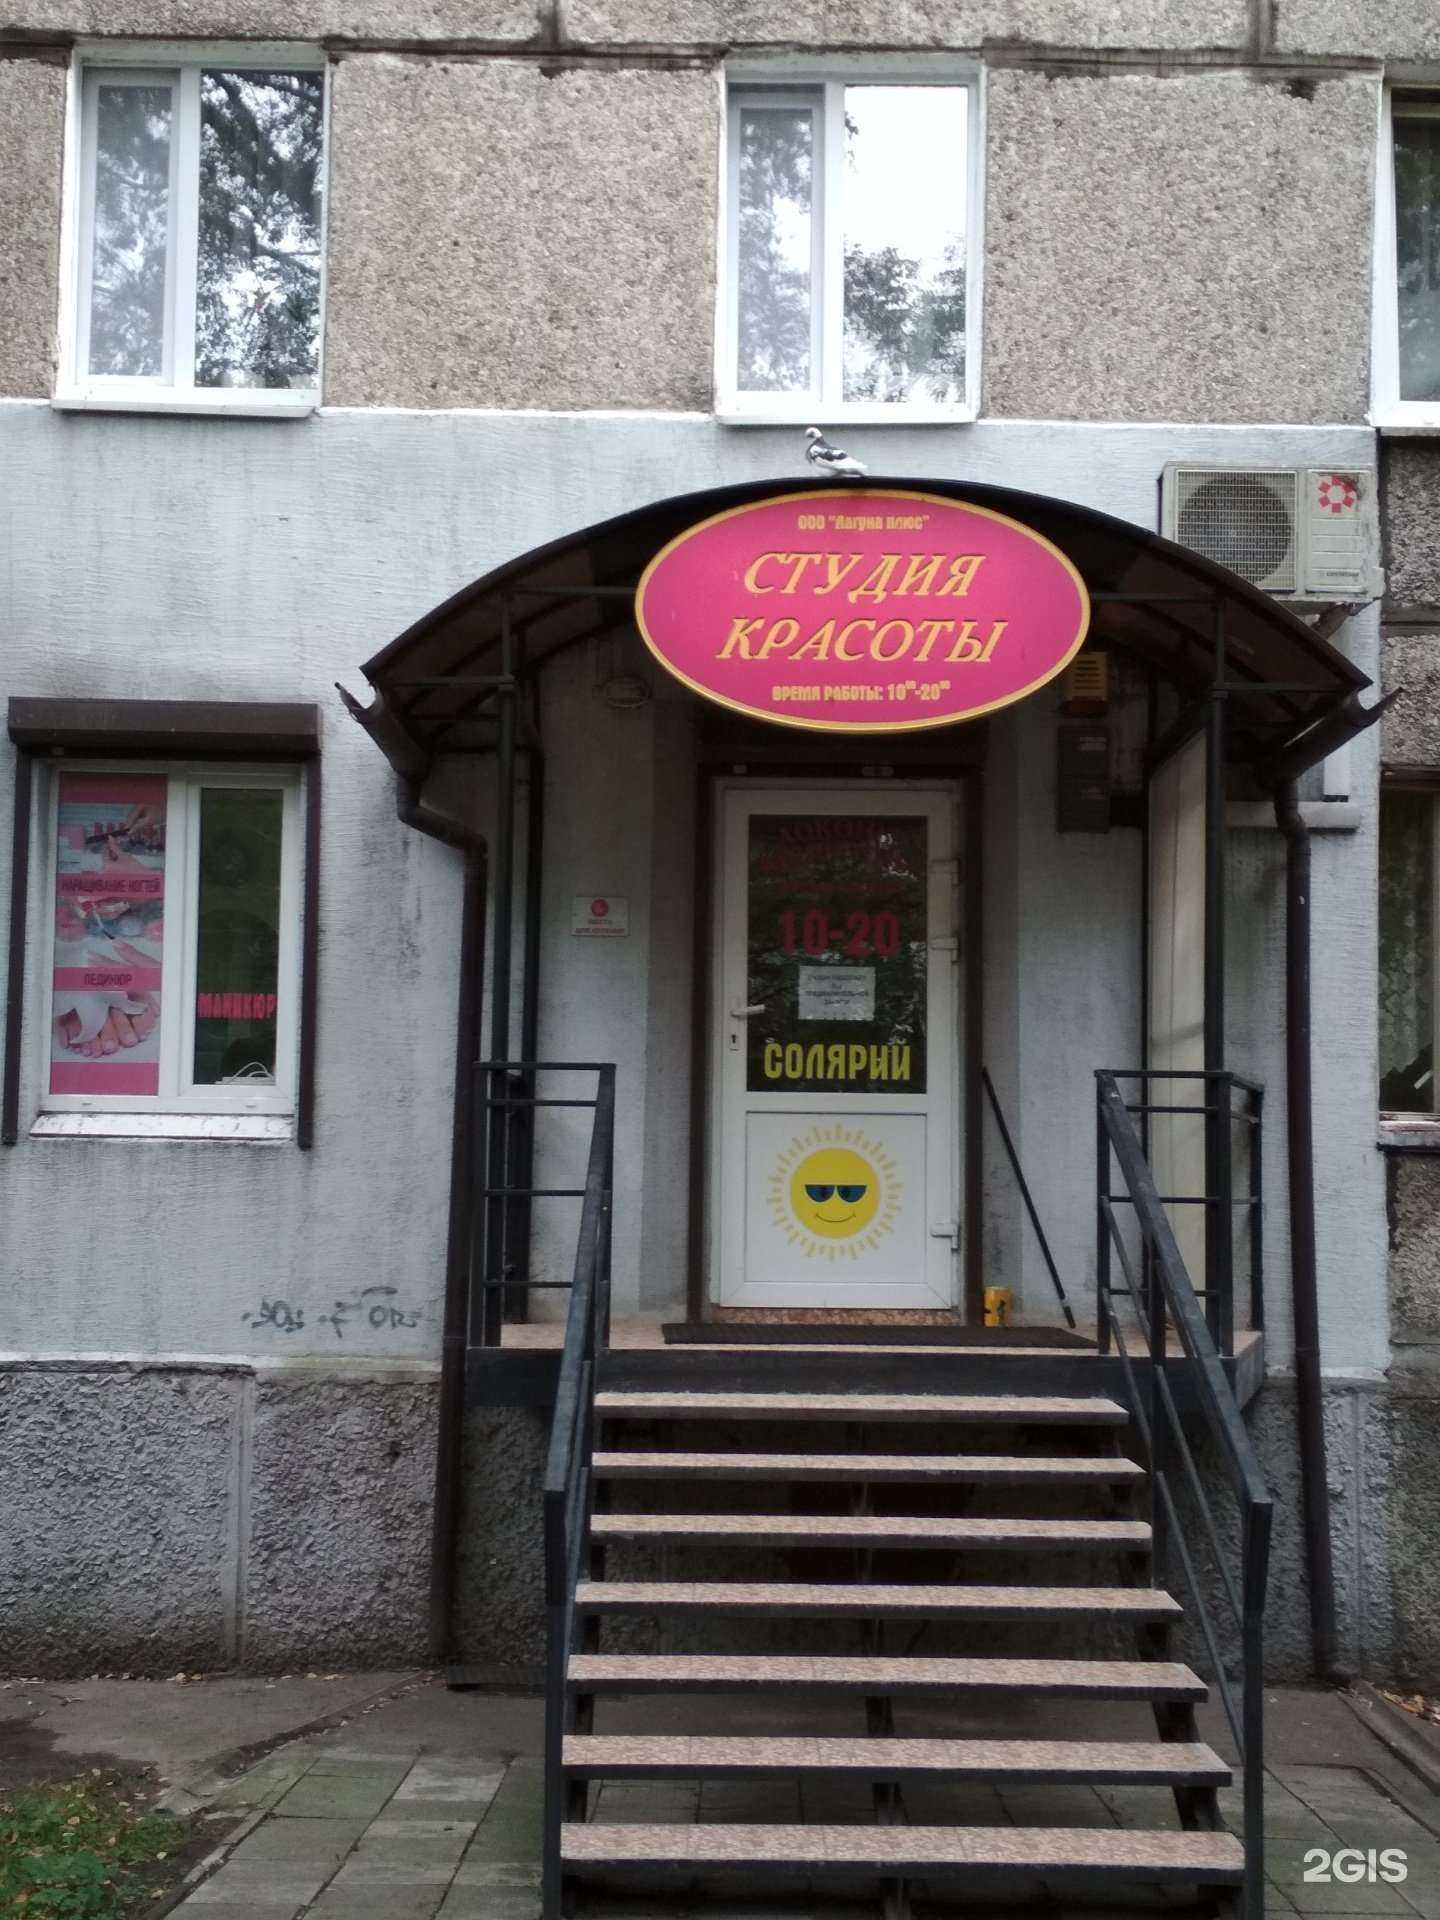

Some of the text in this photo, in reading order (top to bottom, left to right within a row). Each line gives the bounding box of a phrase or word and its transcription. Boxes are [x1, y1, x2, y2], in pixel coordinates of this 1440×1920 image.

[798, 515, 825, 530] ООО
[743, 551, 986, 603] СТУДИЯ
[716, 617, 1008, 662] КРАСОТЫ
[772, 685, 820, 701] ВРЕМЯ
[824, 685, 883, 701] РАБОТЫ:
[779, 910, 902, 957] 10-20
[764, 1038, 911, 1080] СОЛЯРИЙ
